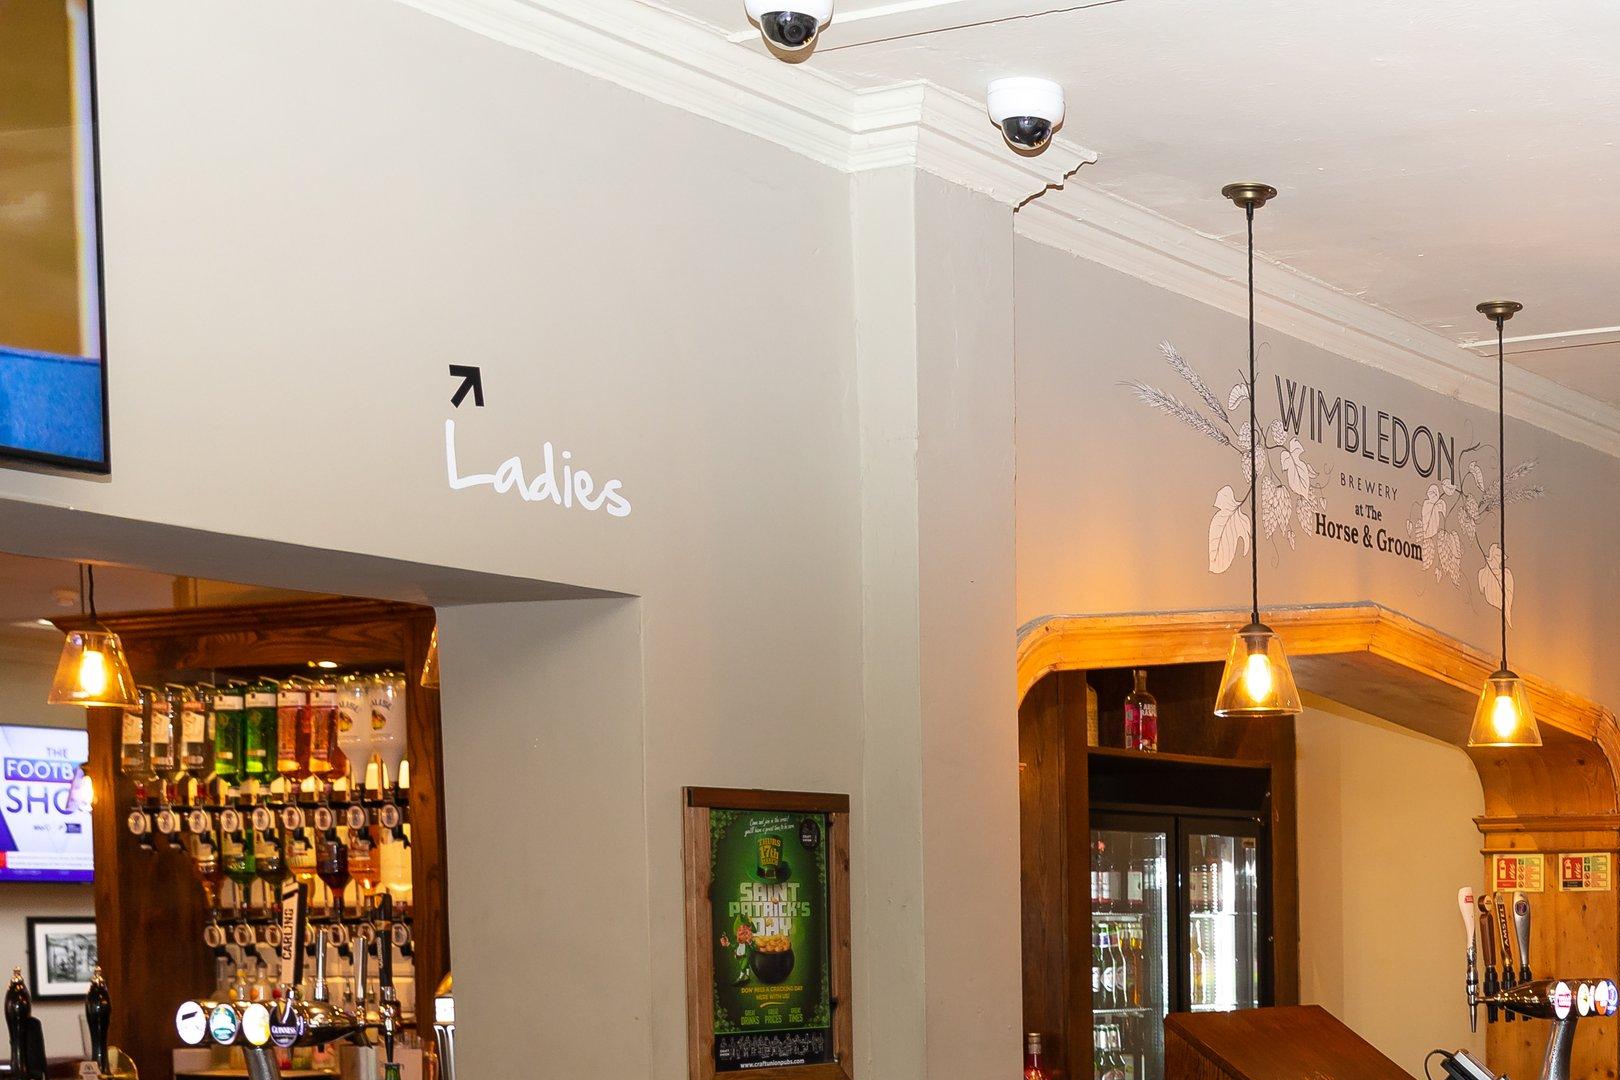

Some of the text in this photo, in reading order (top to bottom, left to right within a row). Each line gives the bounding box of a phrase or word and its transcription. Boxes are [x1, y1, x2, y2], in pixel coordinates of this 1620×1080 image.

[1274, 374, 1455, 485] WIMBLEDON
[445, 418, 632, 517] Ladies
[1340, 472, 1398, 501] BREWERY
[1354, 504, 1382, 521] at The
[1315, 512, 1423, 561] Horse & Groom
[6, 759, 75, 781] FOOTB
[6, 784, 75, 815] SHO
[758, 837, 781, 847] THURS
[760, 846, 779, 860] 17th
[739, 882, 800, 902] SAINT
[728, 901, 811, 918] PATRICK'S
[282, 908, 294, 960] CARLING
[751, 917, 792, 937] DAY
[740, 1058, 805, 1069] www.craftunionpubs.com
